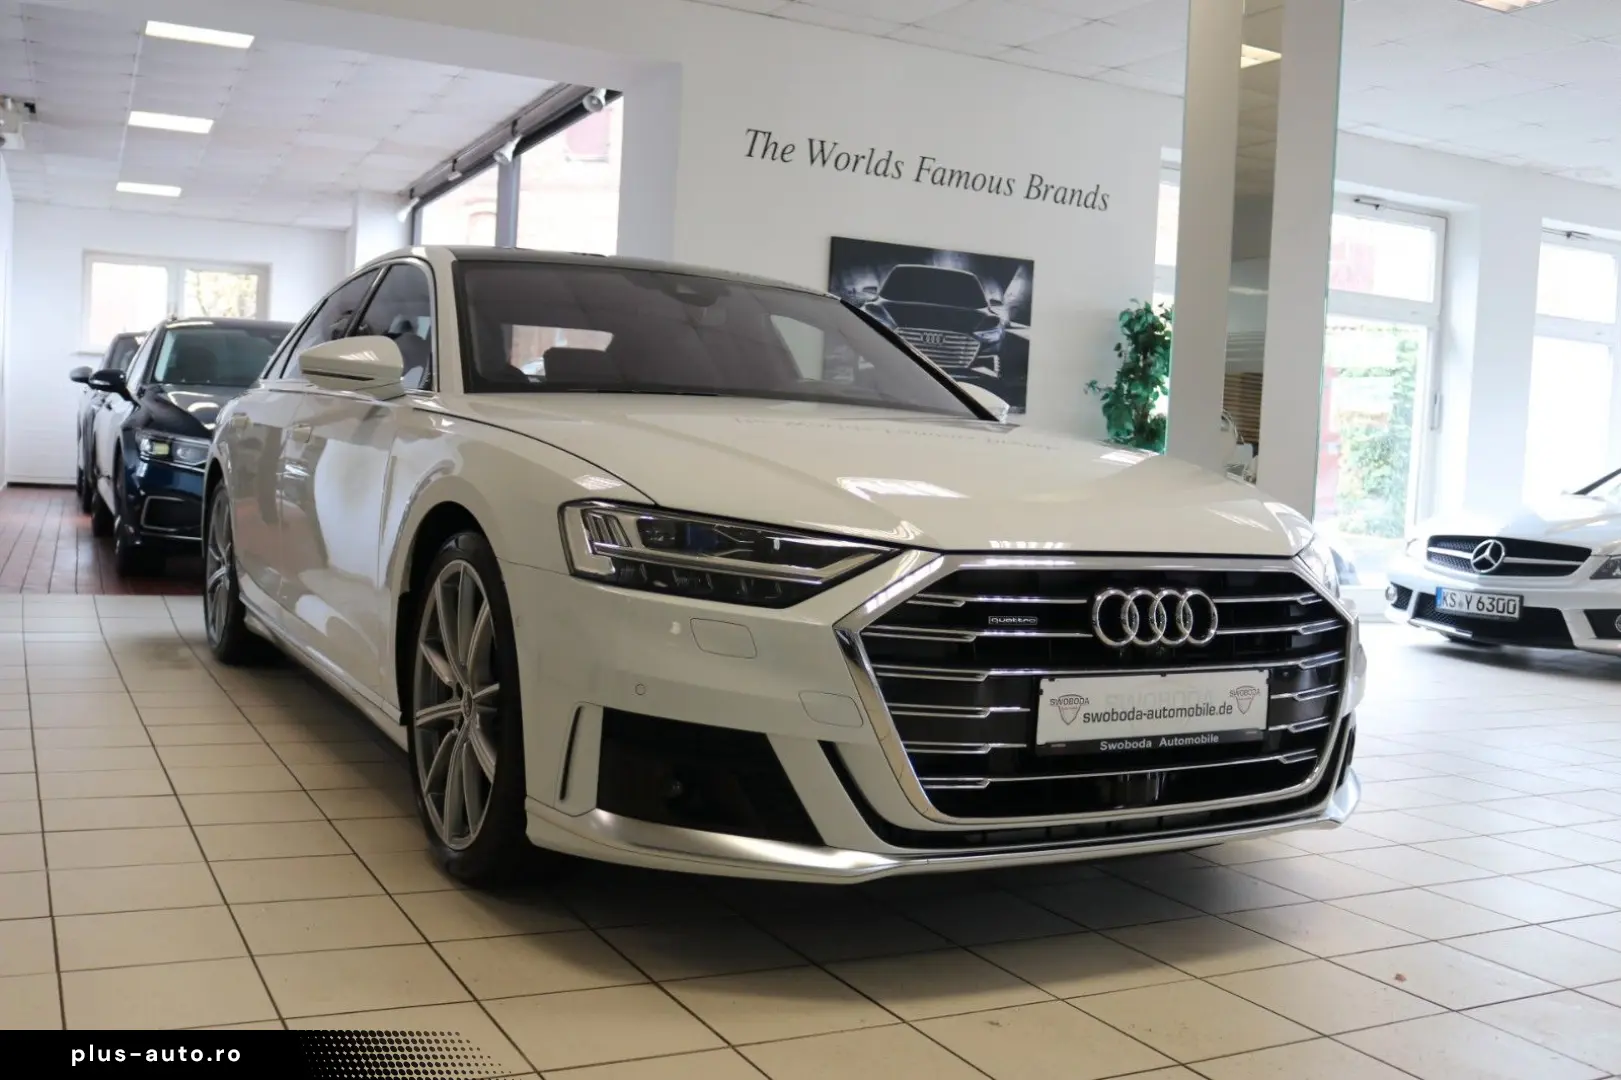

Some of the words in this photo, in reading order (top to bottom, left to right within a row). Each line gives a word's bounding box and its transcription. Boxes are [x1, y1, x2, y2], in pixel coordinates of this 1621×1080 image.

[745, 128, 796, 163] The
[807, 138, 904, 180] Worlds
[914, 156, 1016, 197] Famous
[1023, 173, 1110, 212] Brands
[1442, 593, 1456, 608] KS
[1465, 595, 1473, 610] Y
[1476, 597, 1517, 615] 6300
[1049, 697, 1090, 706] SWOBODA
[1082, 702, 1233, 724] swoboda-automobile.de
[1099, 739, 1152, 751] Swoboda
[1158, 733, 1219, 748] Automobile
